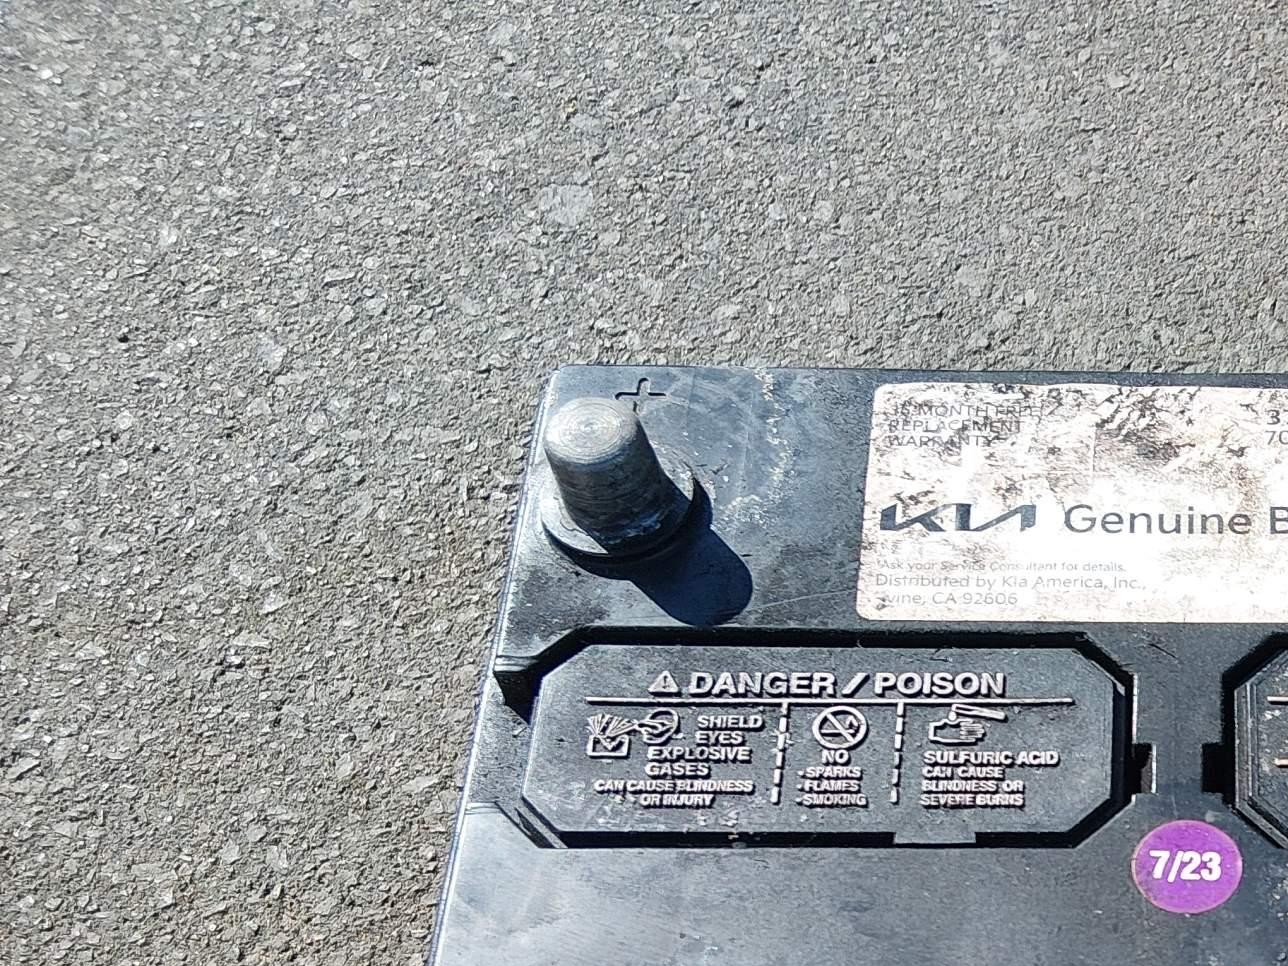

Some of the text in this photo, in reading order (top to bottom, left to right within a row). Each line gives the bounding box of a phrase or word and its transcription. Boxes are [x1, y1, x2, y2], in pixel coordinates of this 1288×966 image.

[879, 503, 1037, 533] KIA
[1063, 503, 1252, 535] Genuine
[906, 561, 938, 572] your
[1061, 561, 1078, 572] for
[875, 573, 970, 588] Distributed
[975, 575, 997, 591] by
[1001, 575, 1028, 588] Kia
[932, 591, 958, 605] CA
[962, 592, 1018, 605] 92606
[688, 671, 836, 696] DANGER
[873, 671, 1005, 696] POISON
[697, 715, 763, 729] SHIELD
[695, 730, 743, 745] EYES
[646, 746, 752, 761] EXPLOSIVE
[820, 750, 850, 764] NO
[923, 750, 1060, 765] SULFURIC ACID
[644, 762, 710, 777] GASES
[921, 766, 1003, 779] CAN CAUSE
[593, 779, 754, 793] CAN CAUSE BLINDNESS
[921, 780, 1025, 792] BLINDNESS OR
[640, 793, 714, 807] OR INJURY
[920, 793, 976, 807] SEVERE
[1149, 849, 1212, 883] 7/23
